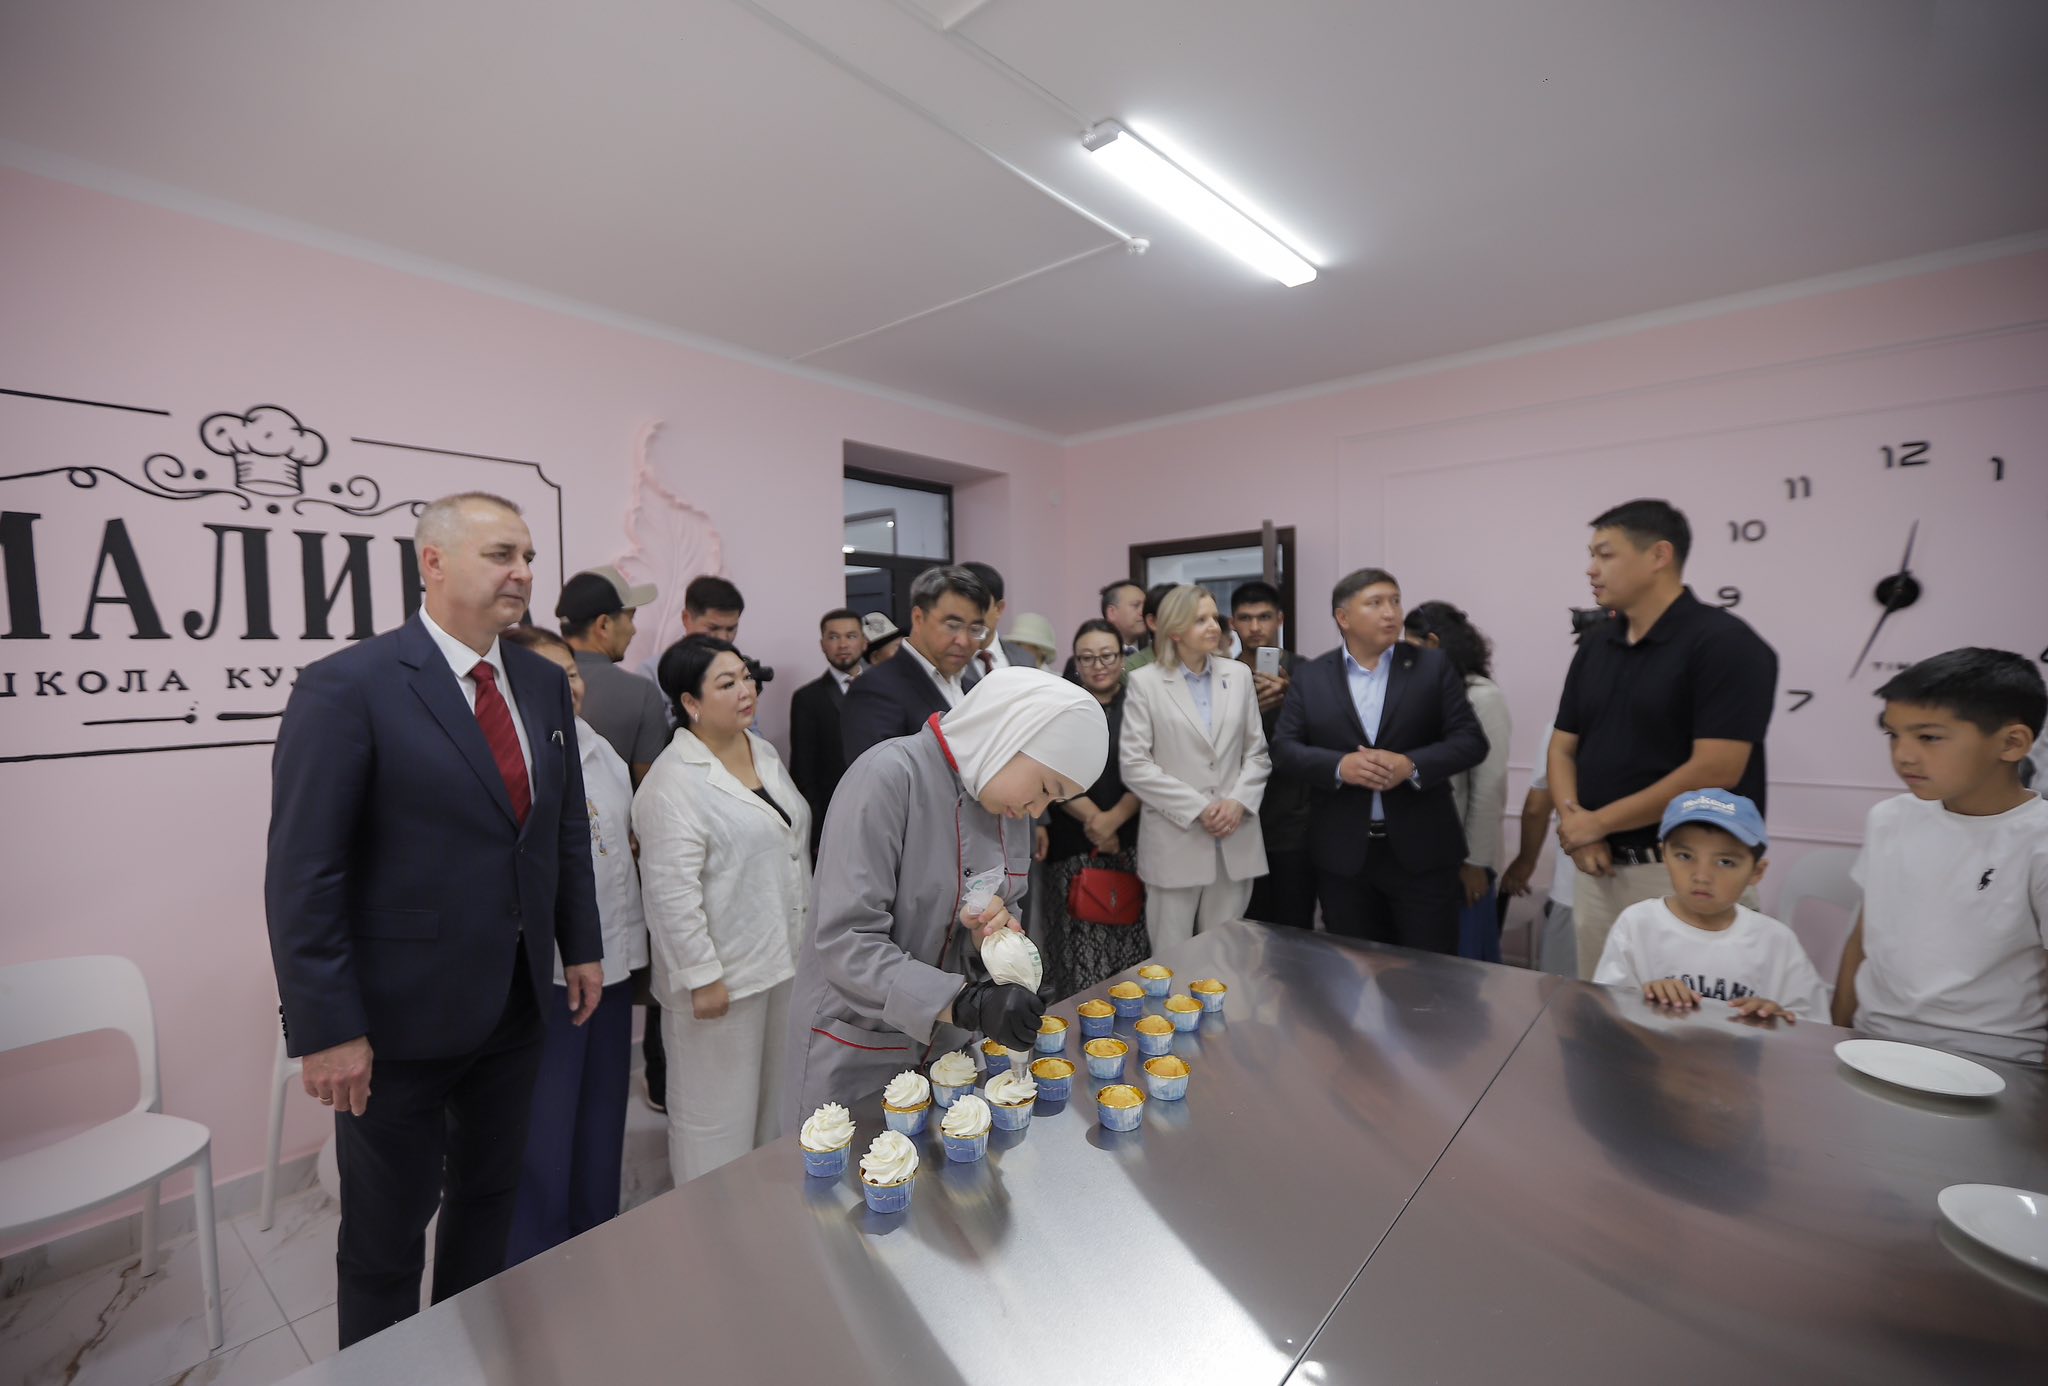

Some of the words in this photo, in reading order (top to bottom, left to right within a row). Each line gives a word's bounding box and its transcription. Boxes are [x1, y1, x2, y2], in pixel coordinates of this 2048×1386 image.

[1879, 441, 1931, 468] 12
[1990, 456, 2004, 481] 1
[1785, 476, 1811, 499] 11
[1728, 519, 1767, 542] 10
[0, 511, 533, 640] АЛИ
[1717, 586, 1741, 608] 9
[1787, 689, 1814, 712] 7
